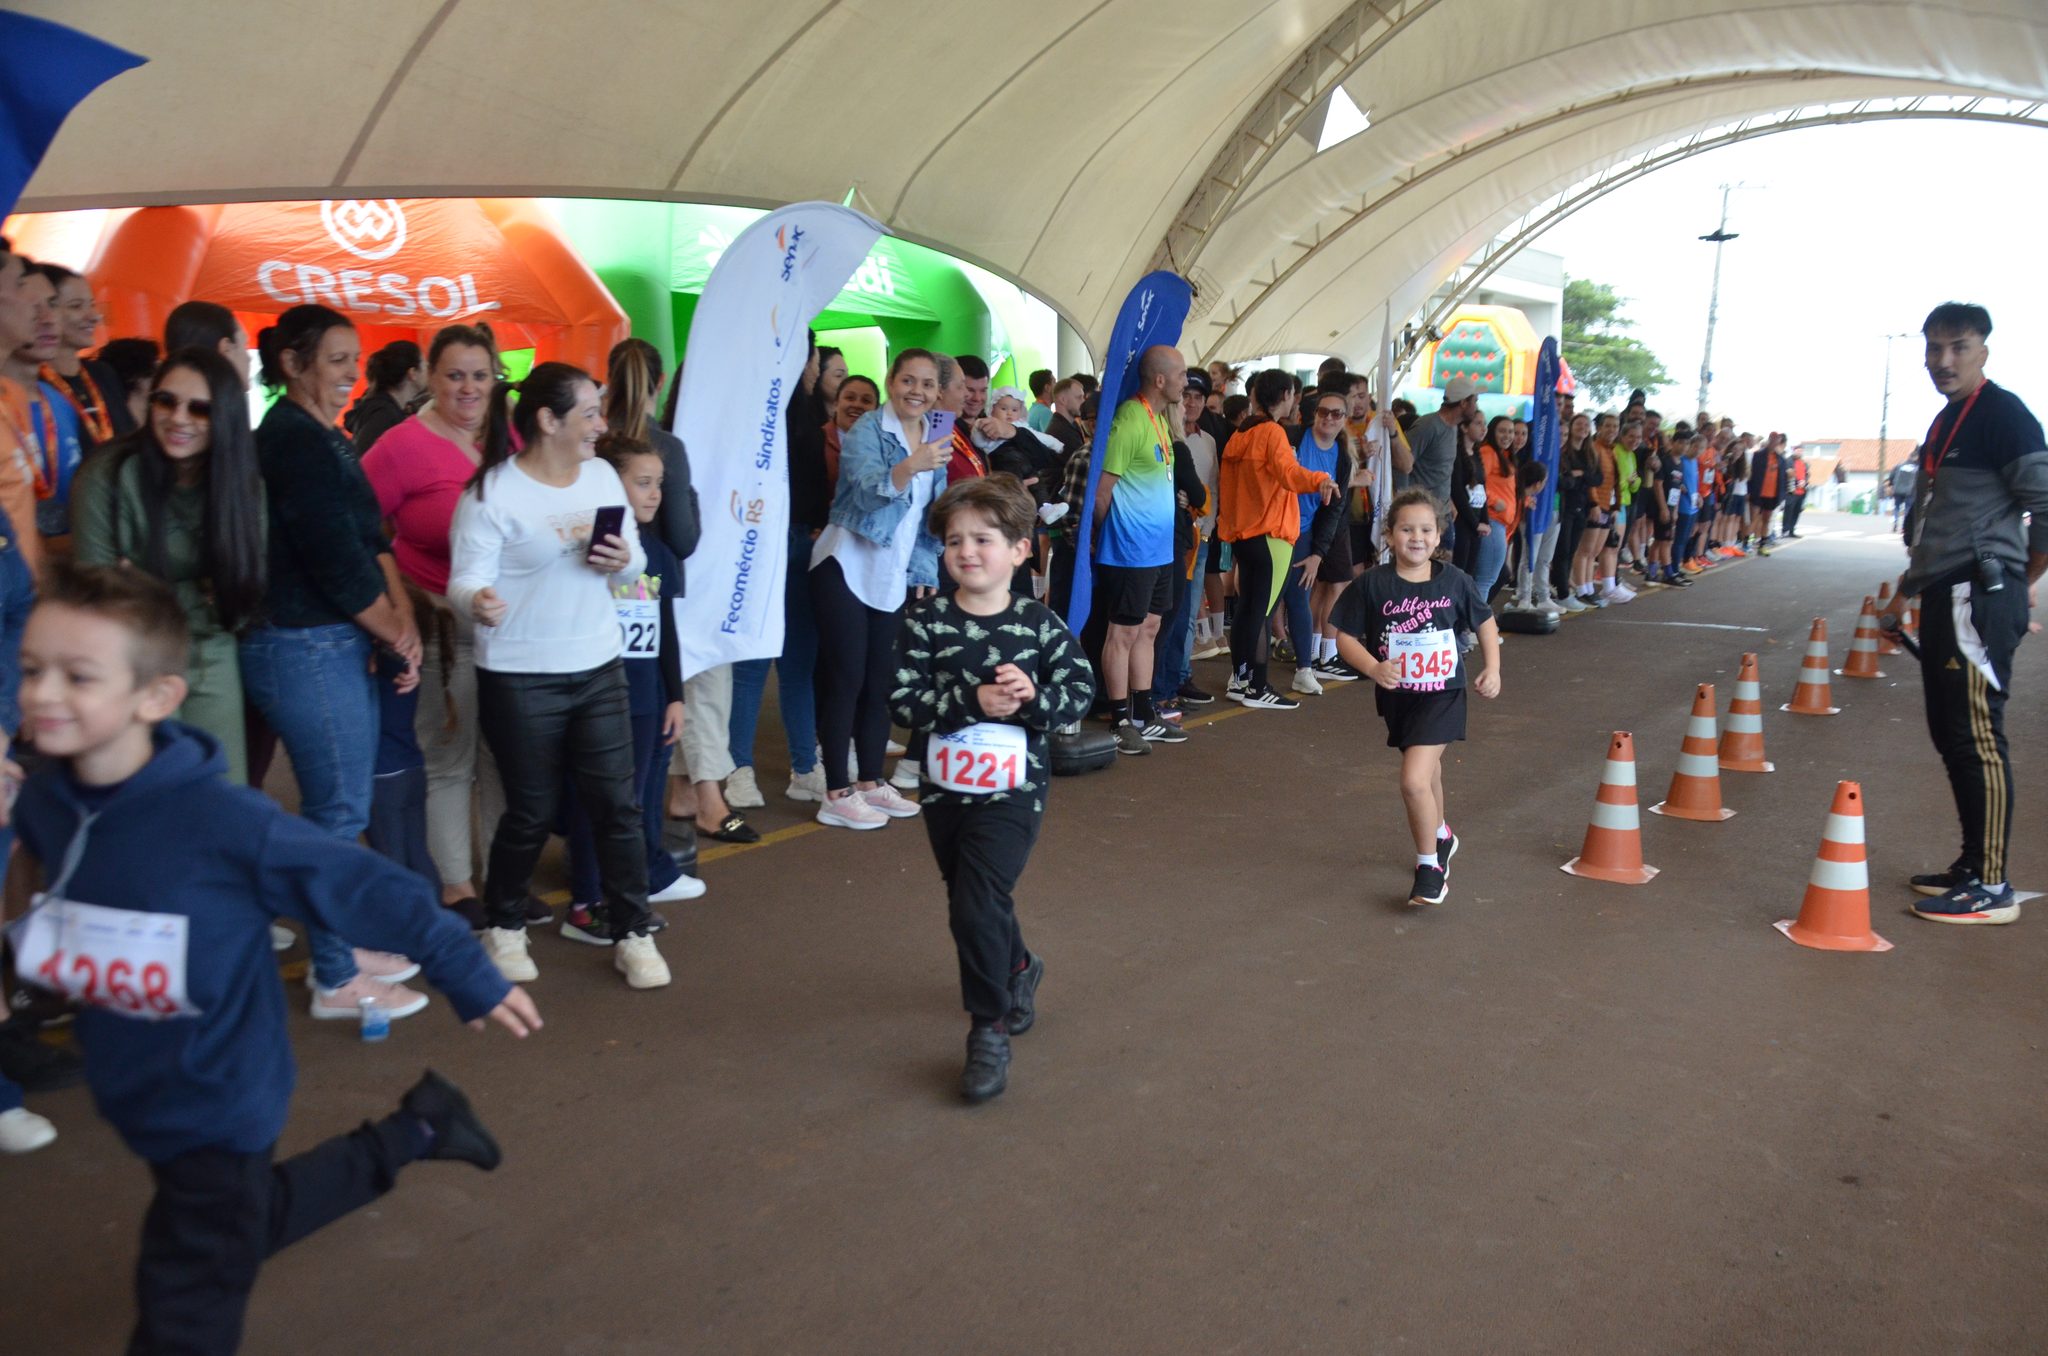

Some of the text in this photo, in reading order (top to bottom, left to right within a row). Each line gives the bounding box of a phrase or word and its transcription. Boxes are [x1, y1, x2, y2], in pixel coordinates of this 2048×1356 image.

[257, 260, 501, 318] CRESOL
[721, 528, 759, 635] Fecomércio
[746, 497, 764, 524] RS
[757, 377, 782, 471] Sindicatos
[1383, 596, 1452, 616] California
[1417, 608, 1433, 623] 98
[1400, 650, 1453, 679] 1345
[936, 746, 1017, 790] 1221
